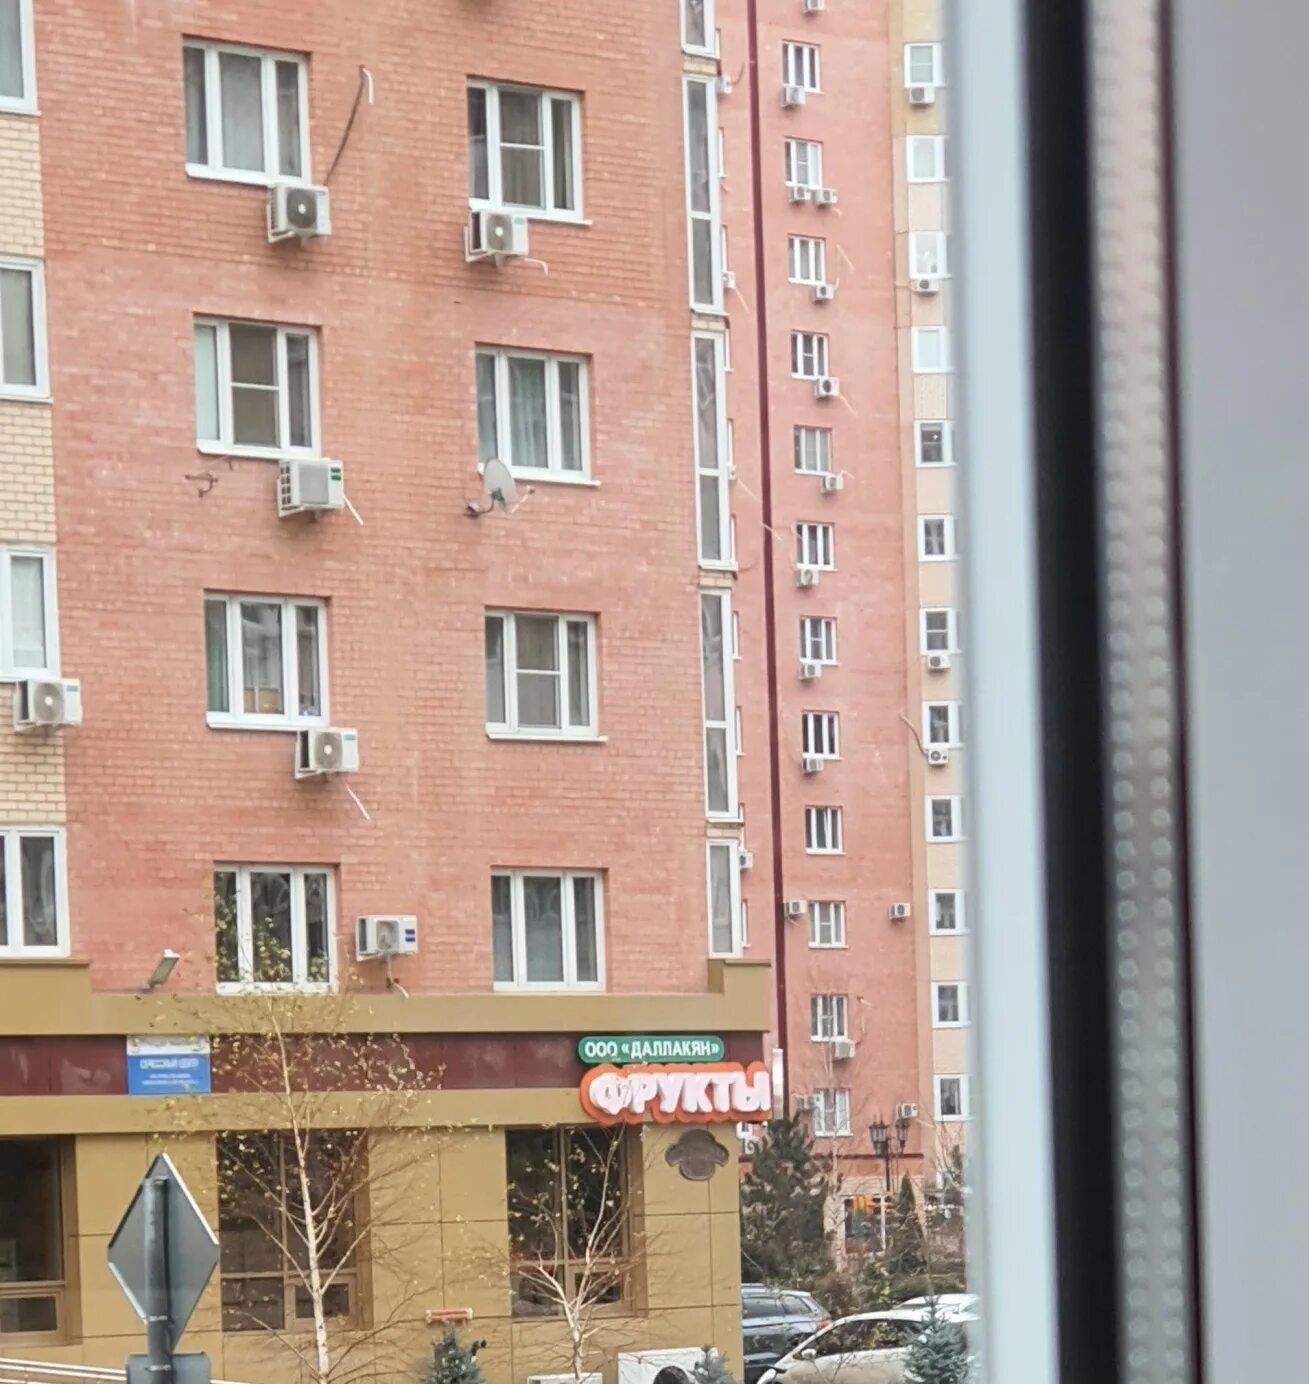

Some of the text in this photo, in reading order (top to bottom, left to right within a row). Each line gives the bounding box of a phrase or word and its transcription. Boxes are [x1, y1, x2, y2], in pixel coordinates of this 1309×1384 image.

[584, 1040, 720, 1058] ООО «ДАЛЛАКЯН»
[588, 1071, 771, 1115] ФРУКТЫ
